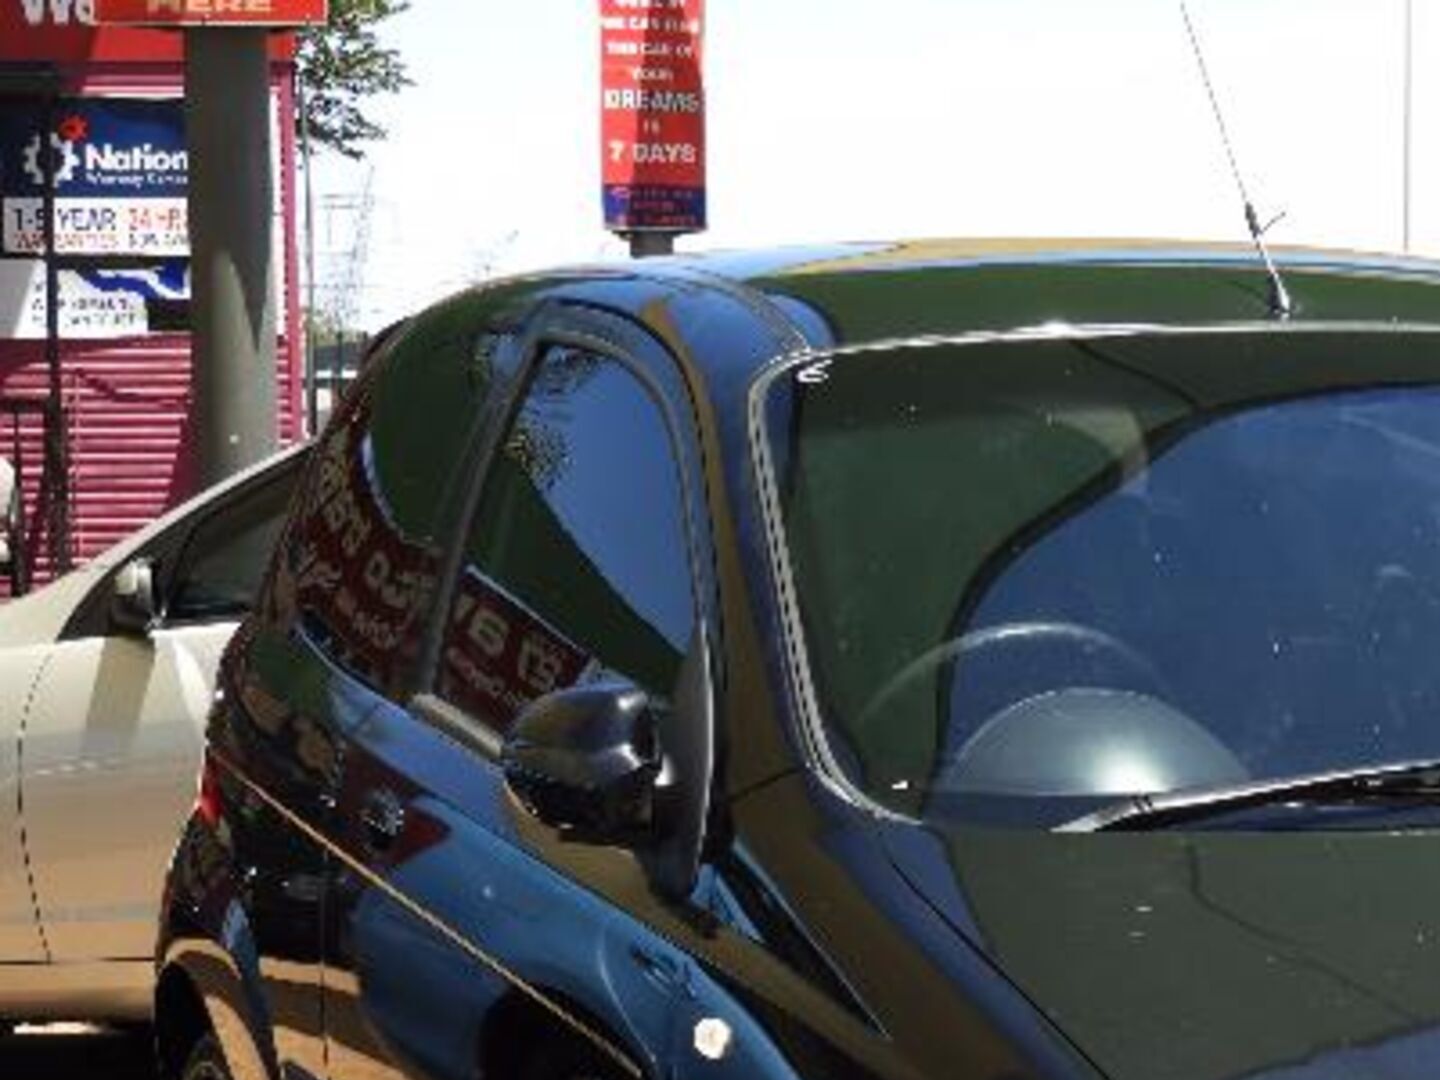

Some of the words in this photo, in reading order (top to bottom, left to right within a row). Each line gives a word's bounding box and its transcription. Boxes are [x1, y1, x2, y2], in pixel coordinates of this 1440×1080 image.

[604, 90, 699, 113] DREAMS
[633, 143, 697, 163] DAYS
[57, 208, 117, 232] YEAR
